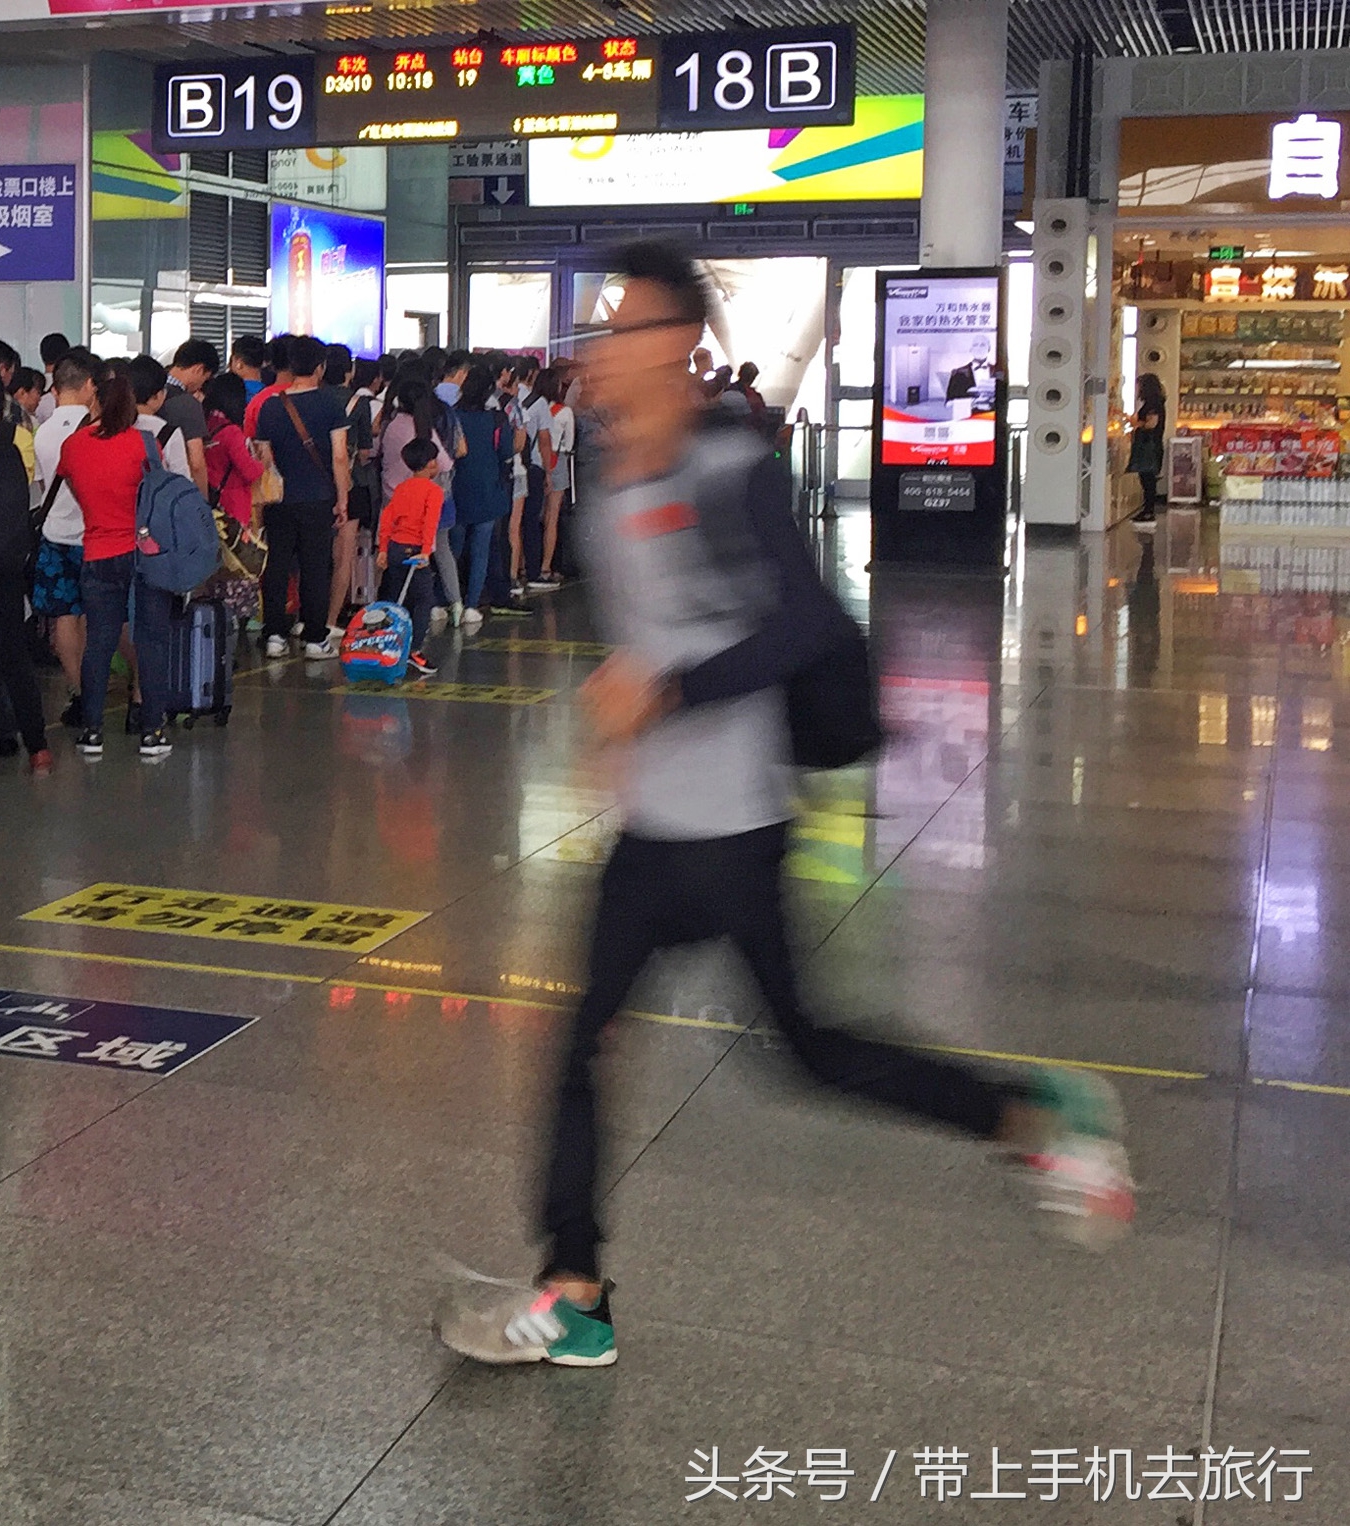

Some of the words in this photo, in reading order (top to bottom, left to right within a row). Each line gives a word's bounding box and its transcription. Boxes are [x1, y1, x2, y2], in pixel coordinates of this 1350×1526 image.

[337, 56, 368, 74] 车次
[395, 53, 425, 71] 开点
[452, 49, 484, 67] 站台
[603, 39, 637, 57] 状态
[324, 74, 373, 94] D3610
[387, 70, 434, 91] 10:18
[457, 68, 478, 87] 19
[517, 65, 555, 86] 黄色
[674, 50, 755, 112] 18
[780, 52, 822, 104] B
[179, 82, 213, 130] B
[234, 74, 303, 130] 19
[1268, 114, 1342, 200] 自
[54, 903, 375, 946] 请勿停留
[93, 889, 402, 929] 行走通道
